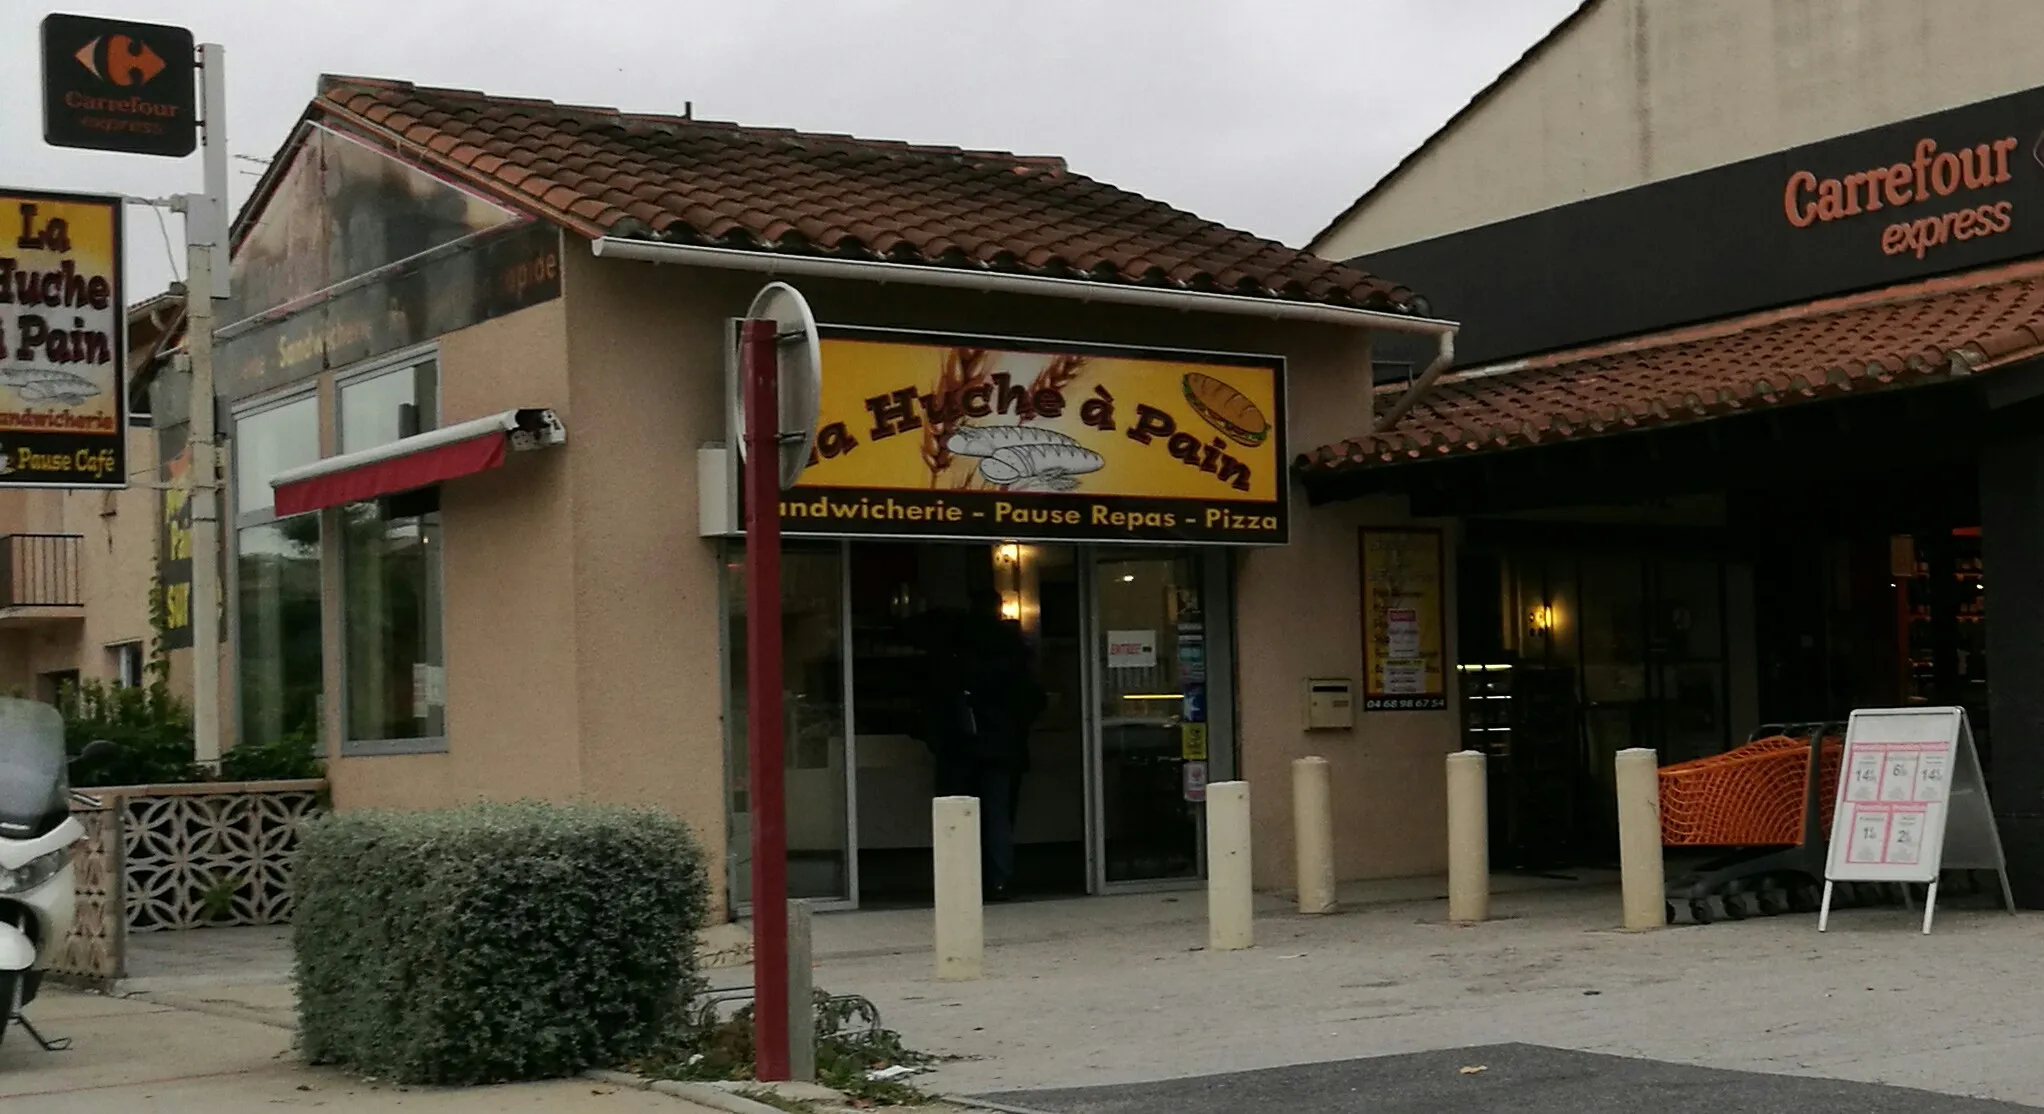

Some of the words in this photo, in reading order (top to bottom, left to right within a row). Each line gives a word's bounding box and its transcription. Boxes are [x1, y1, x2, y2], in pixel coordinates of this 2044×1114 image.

[64, 90, 178, 117] Carrefour
[1784, 136, 2018, 228] Carrefour
[18, 203, 71, 252] La
[1881, 201, 2013, 260] express
[17, 314, 110, 365] Pain
[803, 420, 858, 469] a
[864, 372, 1066, 441] Huche
[1079, 384, 1117, 432] à
[1126, 402, 1253, 492] Pain
[17, 447, 72, 471] Pause
[75, 448, 115, 478] Café
[779, 497, 963, 521] ndwicherie
[995, 502, 1081, 526] Pause
[1092, 506, 1176, 531] Repas
[1206, 508, 1278, 531] Pizza
[1366, 699, 1381, 709] 04
[1383, 699, 1398, 708] 68
[1399, 699, 1414, 708] 98
[1415, 699, 1429, 708] 67
